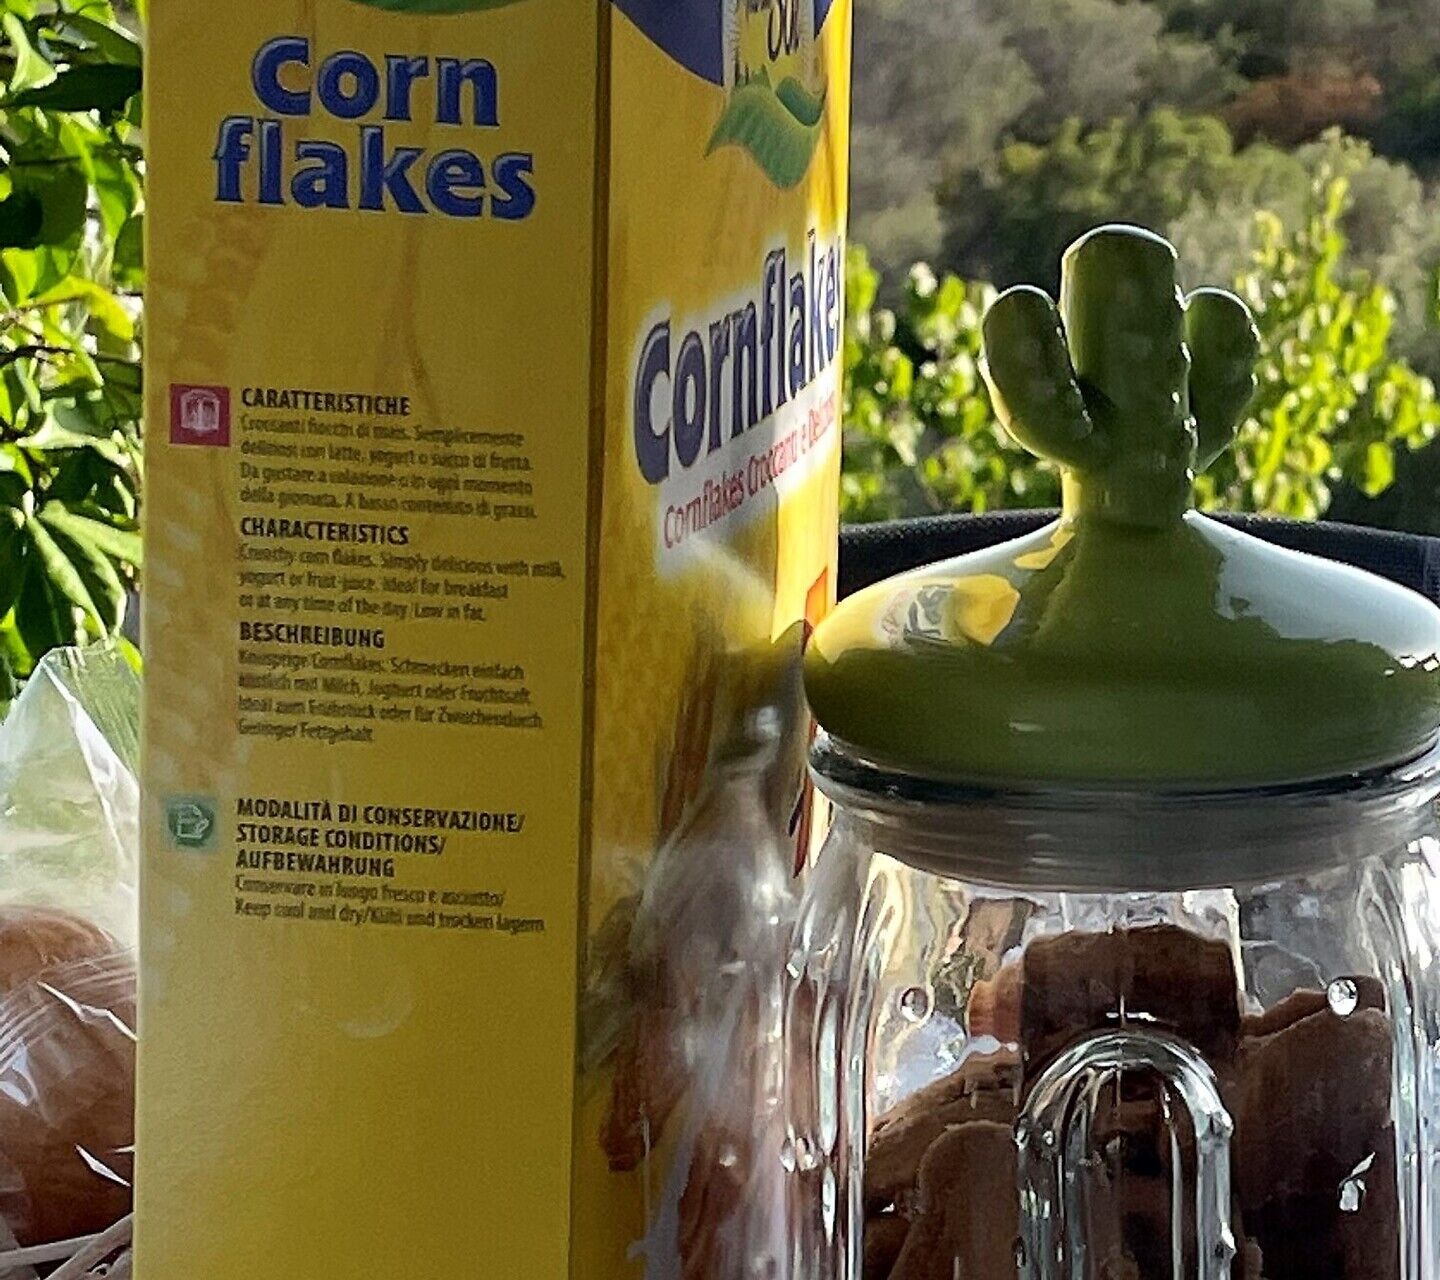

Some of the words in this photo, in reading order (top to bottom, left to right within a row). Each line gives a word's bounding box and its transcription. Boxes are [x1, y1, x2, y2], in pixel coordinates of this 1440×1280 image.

[250, 37, 499, 127] Corn
[212, 116, 537, 220] flakes
[242, 387, 410, 416] CARATTERISTICHE
[241, 517, 409, 545] CHARACTERISTICS
[240, 622, 385, 649] BESCHREIBUNG
[236, 796, 331, 821] MODALITÀ
[338, 803, 357, 823] DI
[363, 805, 525, 832] CONSERVAZIONE/
[235, 823, 319, 846] STORAGE
[325, 829, 446, 855] CONDITIONS/
[235, 848, 394, 877] AUFBEWAHRUNG
[235, 897, 271, 920] Keep
